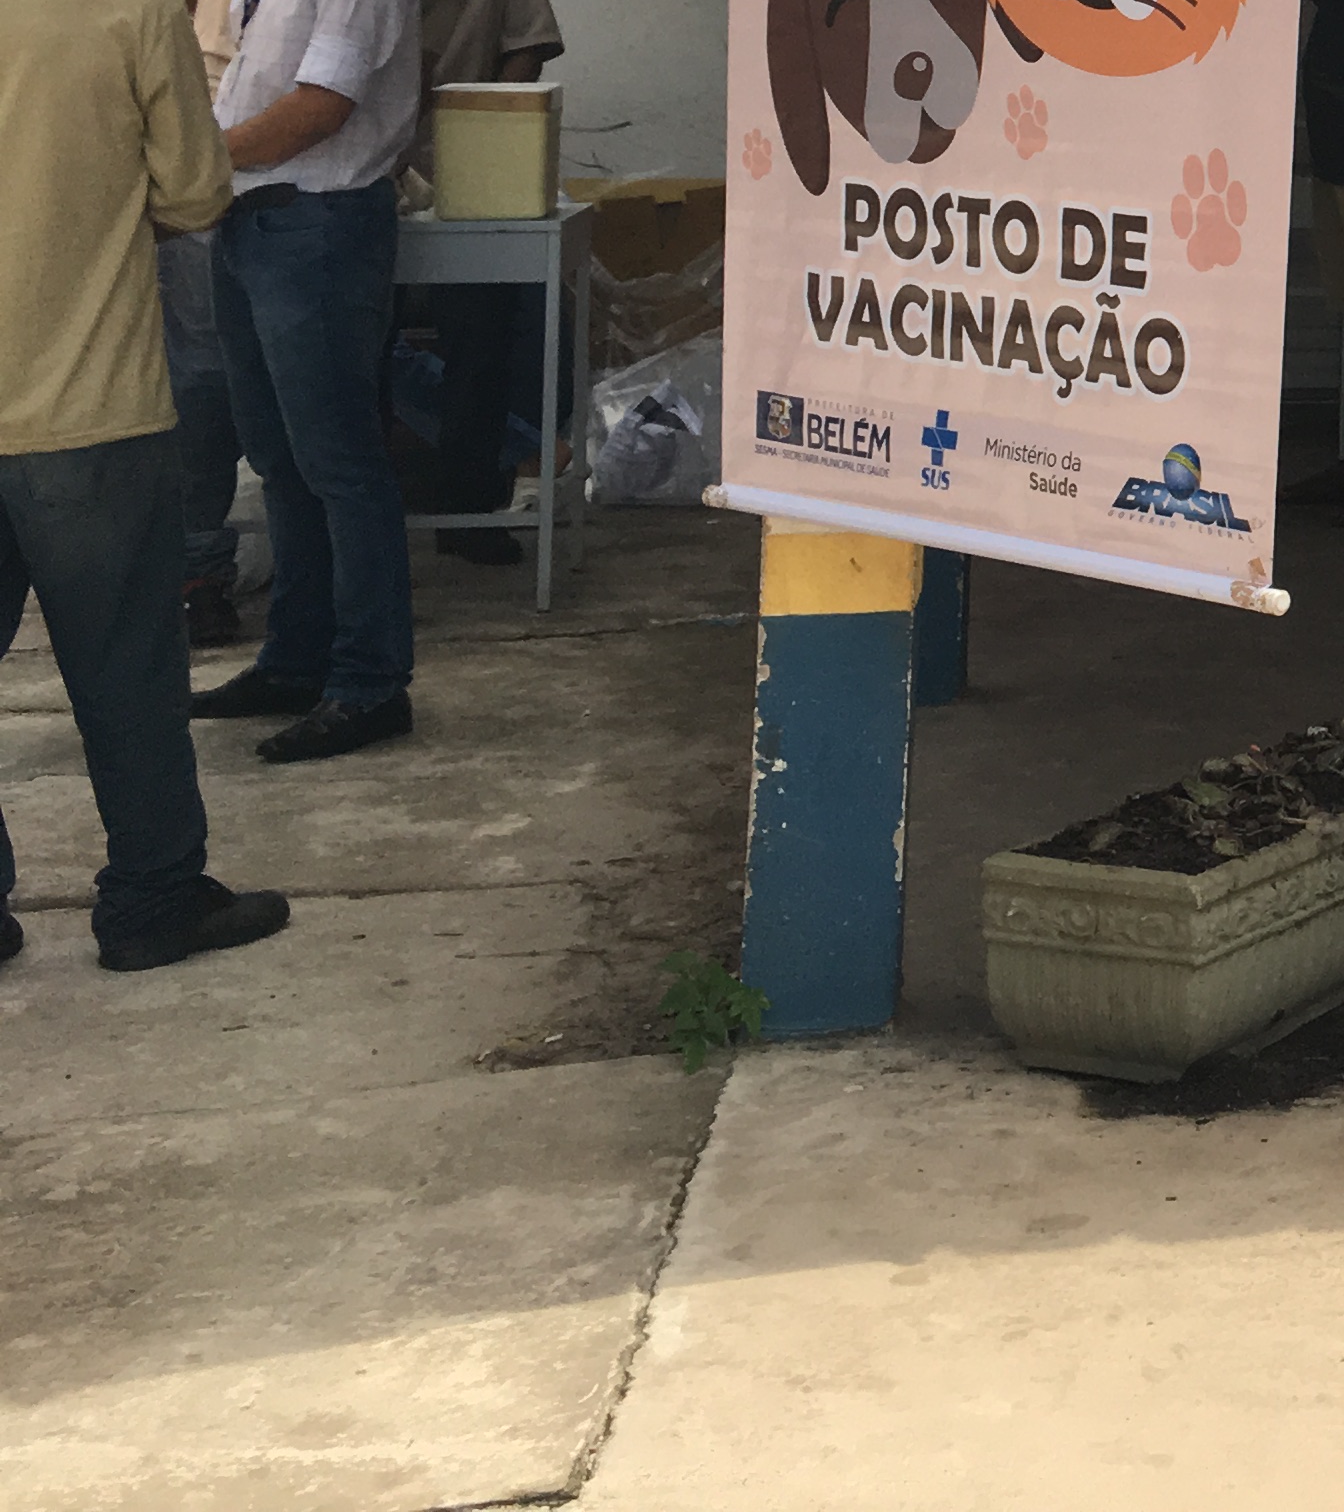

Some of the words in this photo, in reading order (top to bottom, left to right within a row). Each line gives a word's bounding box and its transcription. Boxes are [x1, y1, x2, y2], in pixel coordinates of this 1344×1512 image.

[844, 183, 1040, 275] POSTO
[1061, 207, 1149, 289] DE
[807, 272, 1186, 398] VACINAÇÃO
[881, 410, 895, 421] DE
[807, 413, 891, 463] BELÉM
[984, 437, 1057, 467] Ministério
[1061, 451, 1081, 472] da
[921, 467, 950, 490] SUS
[1029, 471, 1078, 498] Saúde
[1107, 509, 1176, 529] GOVERNO
[1112, 477, 1252, 533] BRASIL
